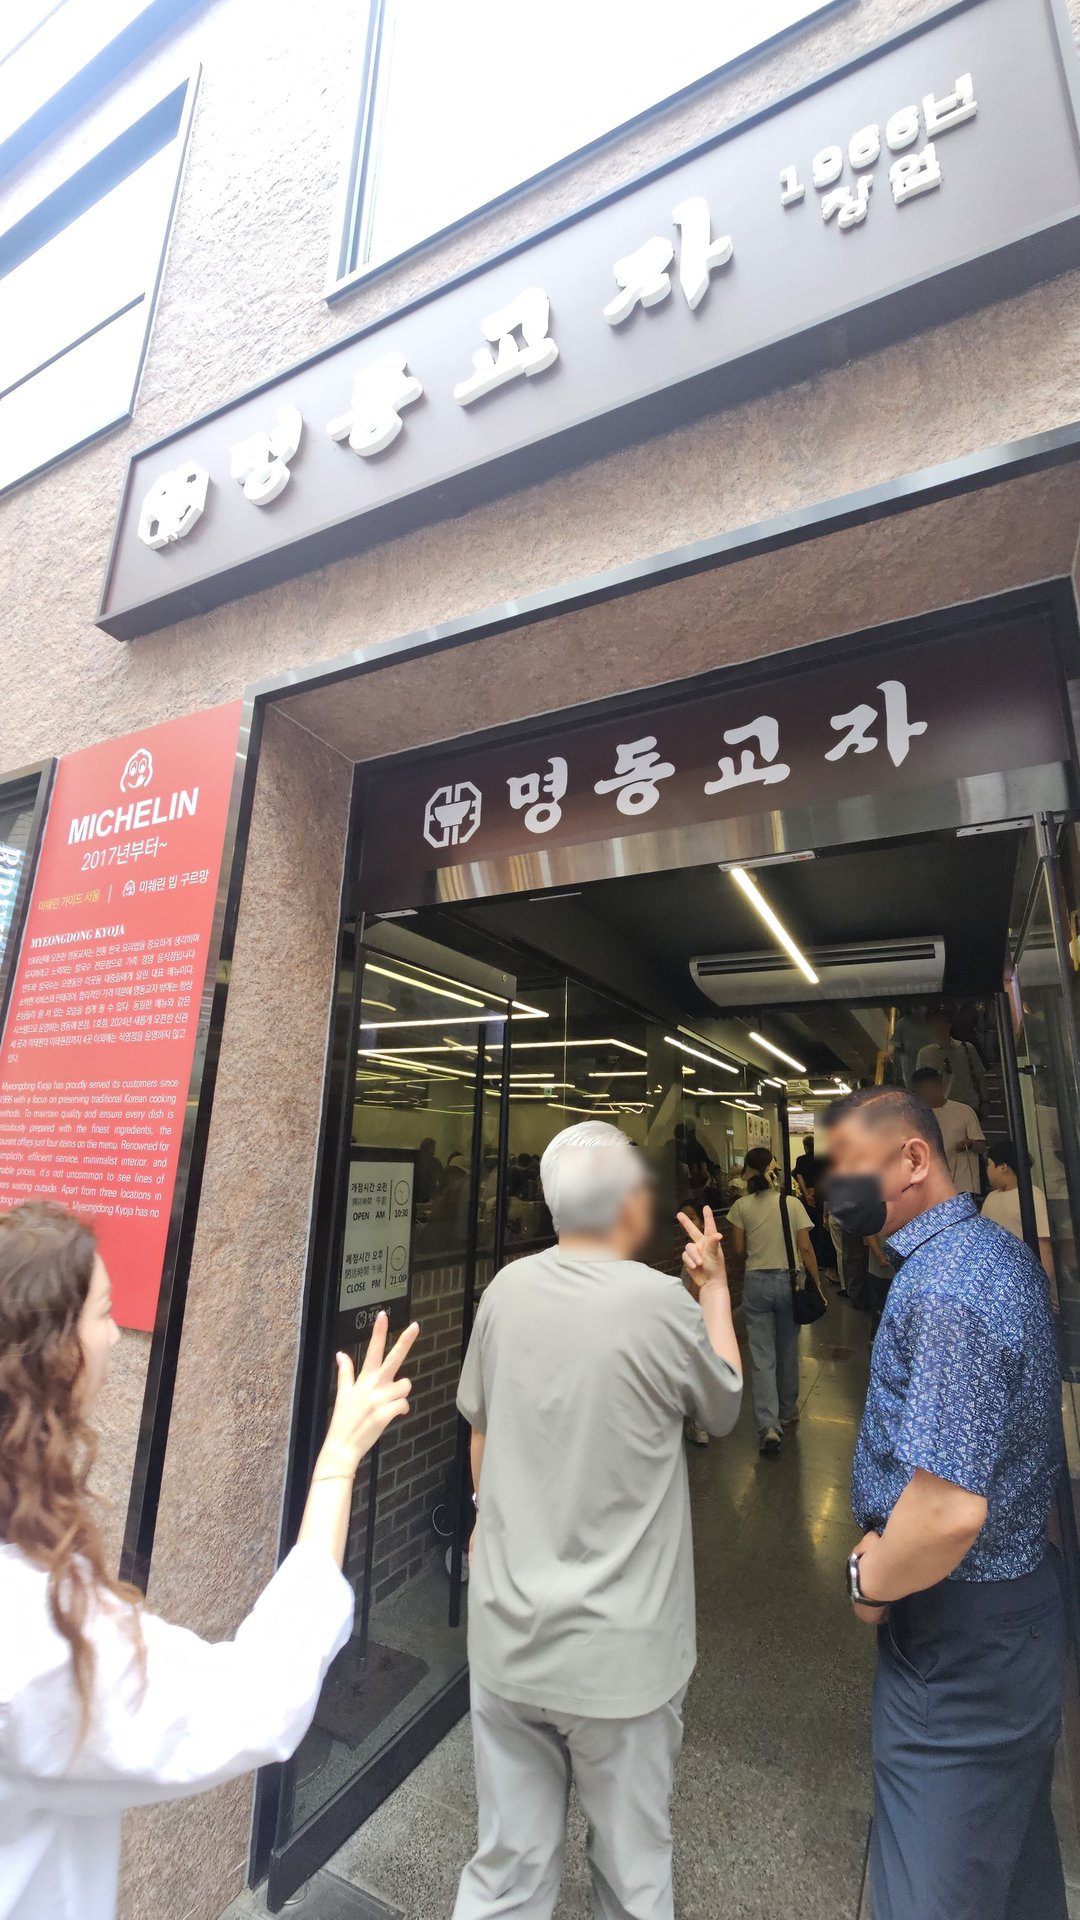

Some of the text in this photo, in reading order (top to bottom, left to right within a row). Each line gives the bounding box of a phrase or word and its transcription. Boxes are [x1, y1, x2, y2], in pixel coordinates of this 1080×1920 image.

[229, 196, 735, 507] 명동교자
[506, 679, 928, 834] 명동교자
[67, 786, 200, 845] MICHELIN
[81, 836, 168, 871] 2017년부터~
[139, 878, 166, 894] 미쉐린
[180, 869, 210, 887] 구르망
[61, 892, 83, 907] 가이드
[84, 889, 101, 904] 서울
[30, 924, 125, 949] MYEONGDONG KYOJA
[54, 1080, 64, 1090] has
[65, 1080, 87, 1090] proudly
[89, 1080, 110, 1089] served
[112, 1080, 120, 1088] its
[122, 1080, 158, 1088] customers
[160, 1080, 179, 1088] since
[32, 1095, 48, 1104] focus
[49, 1096, 57, 1104] on
[58, 1095, 90, 1106] preserving
[91, 1094, 122, 1104] traditional
[124, 1094, 148, 1103] Korean
[149, 1094, 176, 1105] cooking
[25, 1108, 32, 1118] To
[60, 1109, 82, 1120] quality
[84, 1109, 98, 1118] and
[100, 1110, 123, 1119] ensure
[125, 1110, 146, 1120] every
[148, 1109, 164, 1119] dish
[167, 1110, 174, 1119] is
[29, 1124, 56, 1135] prepared
[58, 1124, 72, 1133] with
[76, 1124, 87, 1134] the
[92, 1124, 110, 1134] finest
[160, 1125, 172, 1136] the
[77, 1140, 86, 1149] on
[87, 1140, 98, 1150] the
[121, 1140, 158, 1152] Renowned
[159, 1141, 170, 1152] for
[83, 1156, 118, 1166] minimalist
[152, 1158, 168, 1168] and
[53, 1170, 64, 1178] not
[66, 1171, 104, 1180] uncommon
[107, 1172, 114, 1182] to
[118, 1174, 132, 1182] see
[135, 1173, 153, 1184] lines
[156, 1173, 166, 1184] of
[61, 1184, 79, 1196] Apart
[80, 1185, 97, 1196] from
[100, 1186, 118, 1198] three
[120, 1188, 152, 1200] locations
[155, 1192, 162, 1201] in
[351, 1182, 388, 1194] 개점시간 오전
[72, 1201, 114, 1217] Myeongdong
[116, 1204, 134, 1218] Kyoja
[136, 1206, 148, 1218] has
[150, 1208, 160, 1218] no
[353, 1209, 408, 1221] OPEN AM 10:30
[372, 1249, 383, 1260] 오후
[346, 1274, 407, 1294] CLOSE PM 21:00
